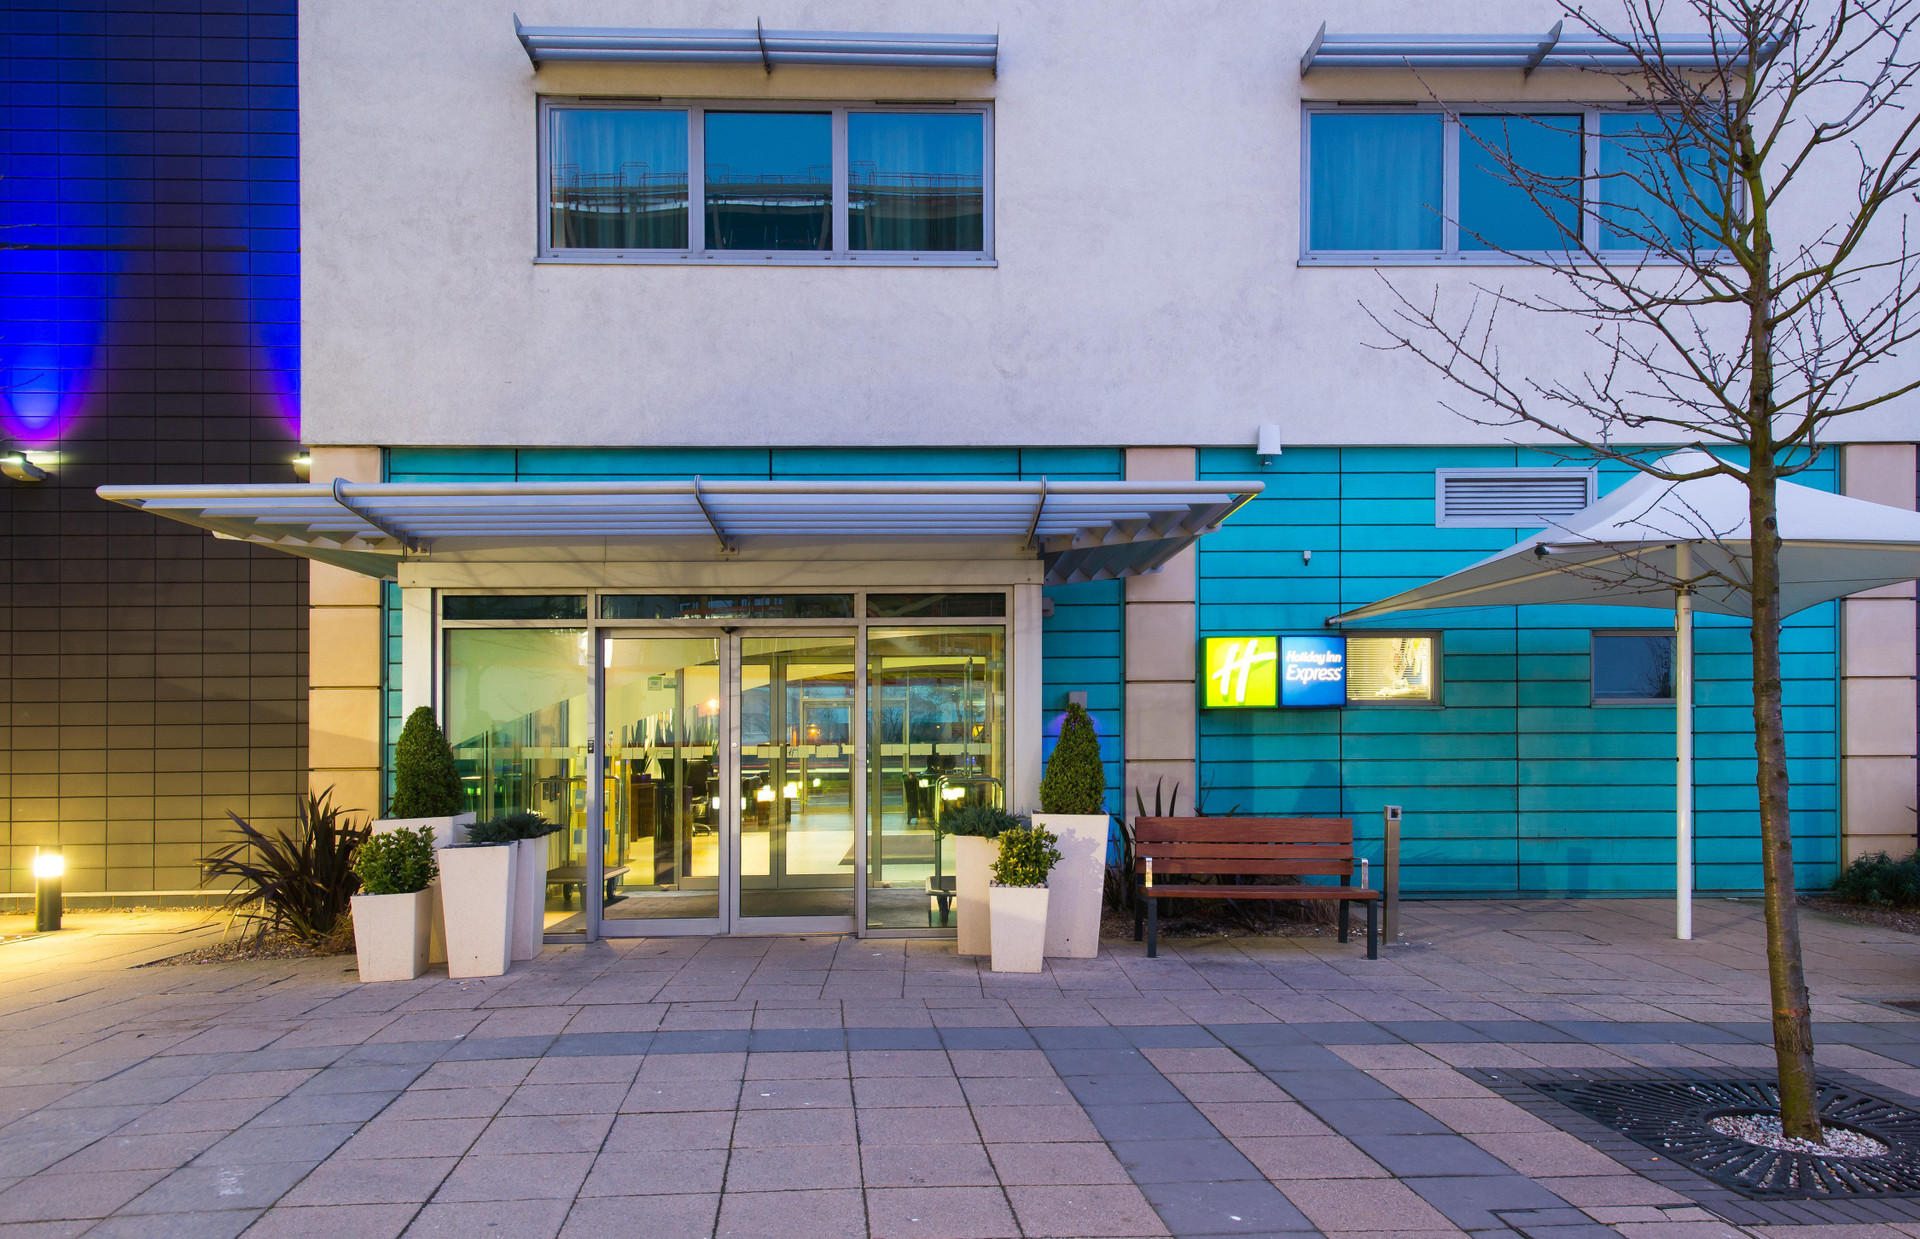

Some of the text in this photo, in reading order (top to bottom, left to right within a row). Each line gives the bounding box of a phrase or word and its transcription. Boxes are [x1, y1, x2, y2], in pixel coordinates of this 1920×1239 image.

[1286, 650, 1342, 665] Holiday Inn
[1286, 664, 1342, 685] Express
